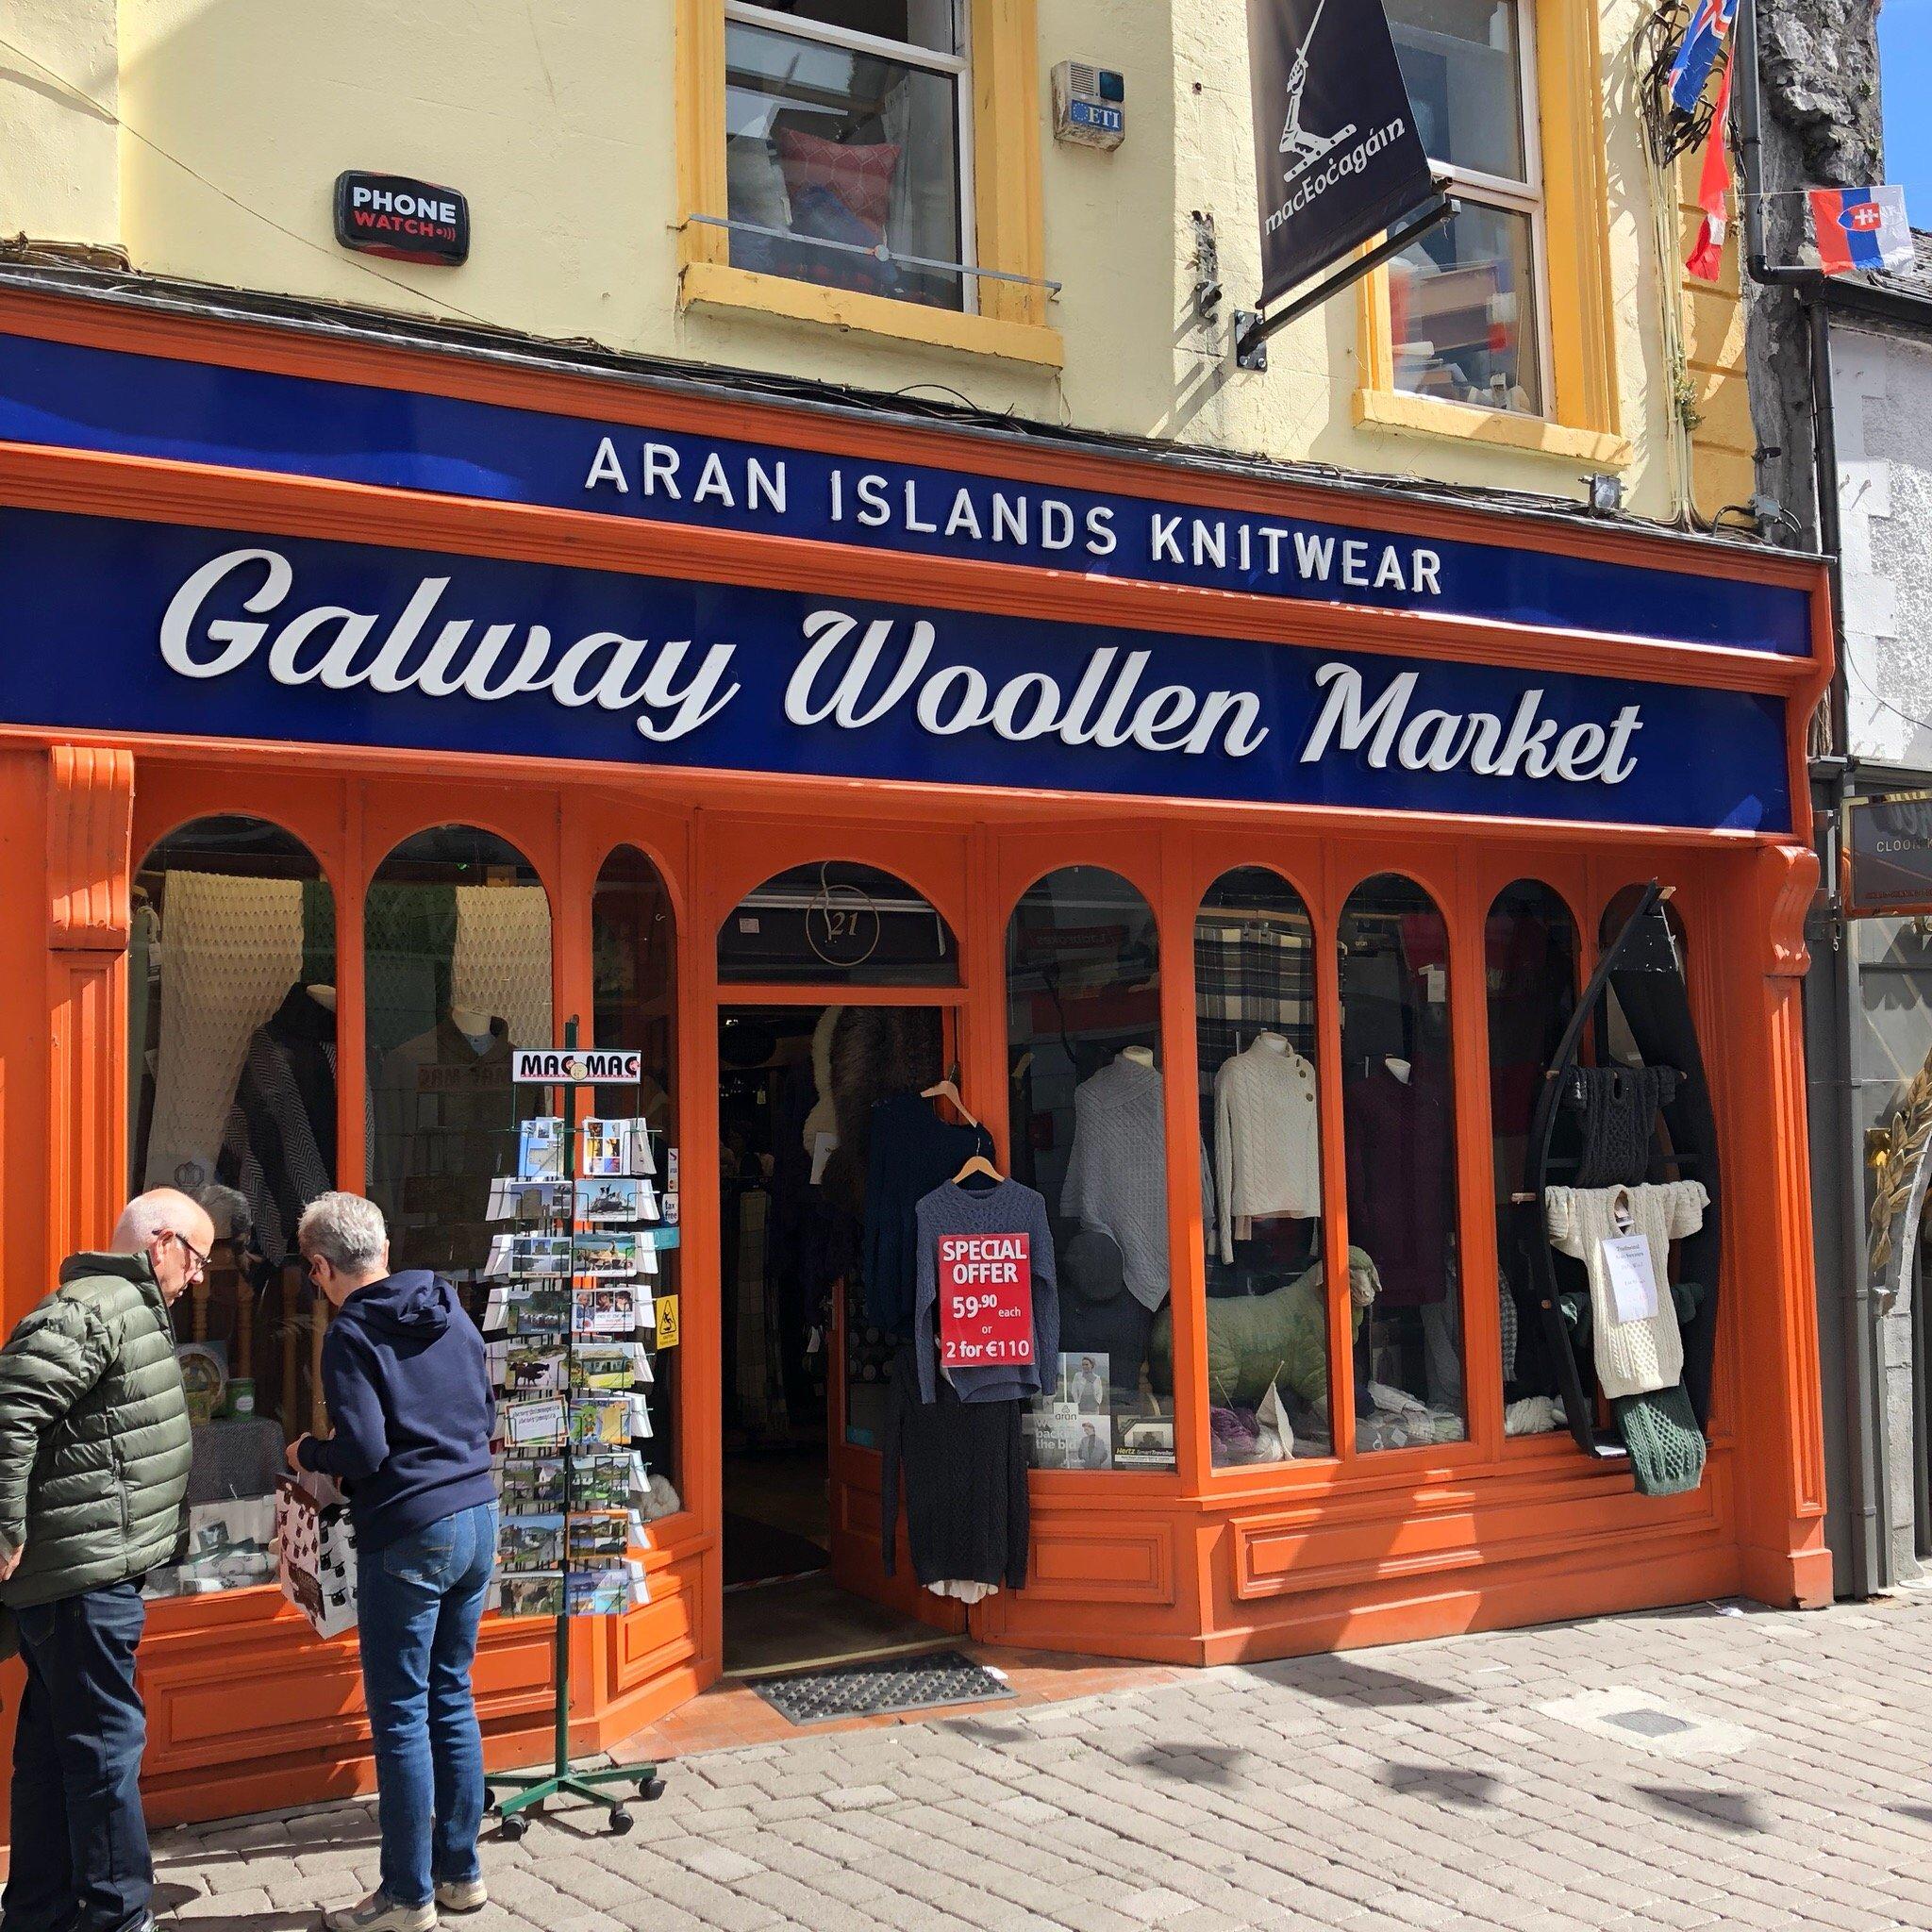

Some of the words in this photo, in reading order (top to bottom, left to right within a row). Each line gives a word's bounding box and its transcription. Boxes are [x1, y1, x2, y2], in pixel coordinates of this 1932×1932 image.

[1088, 107, 1120, 129] ETI
[354, 186, 458, 225] PHONE
[355, 210, 435, 238] WATCH
[584, 437, 788, 514] ARAN
[830, 470, 1120, 557] ISLANDS
[1150, 513, 1443, 596] KNITWEAR
[159, 548, 742, 742] Galway
[784, 610, 1271, 758] Woollen
[1300, 662, 1644, 785] Market
[831, 912, 858, 936] 21
[521, 1054, 575, 1076] MAC
[584, 1055, 639, 1077] MAC
[664, 1209, 678, 1221] free
[665, 1200, 675, 1210] tax
[942, 1239, 1028, 1261] SPECIAL
[953, 1262, 1019, 1285] OFFER
[953, 1293, 997, 1319] 59.90
[998, 1307, 1022, 1318] each
[981, 1324, 992, 1334] or
[946, 1341, 957, 1358] 2
[959, 1341, 984, 1358] for
[986, 1340, 1030, 1357] €110
[1055, 1412, 1077, 1421] aran
[1036, 1439, 1056, 1450] the
